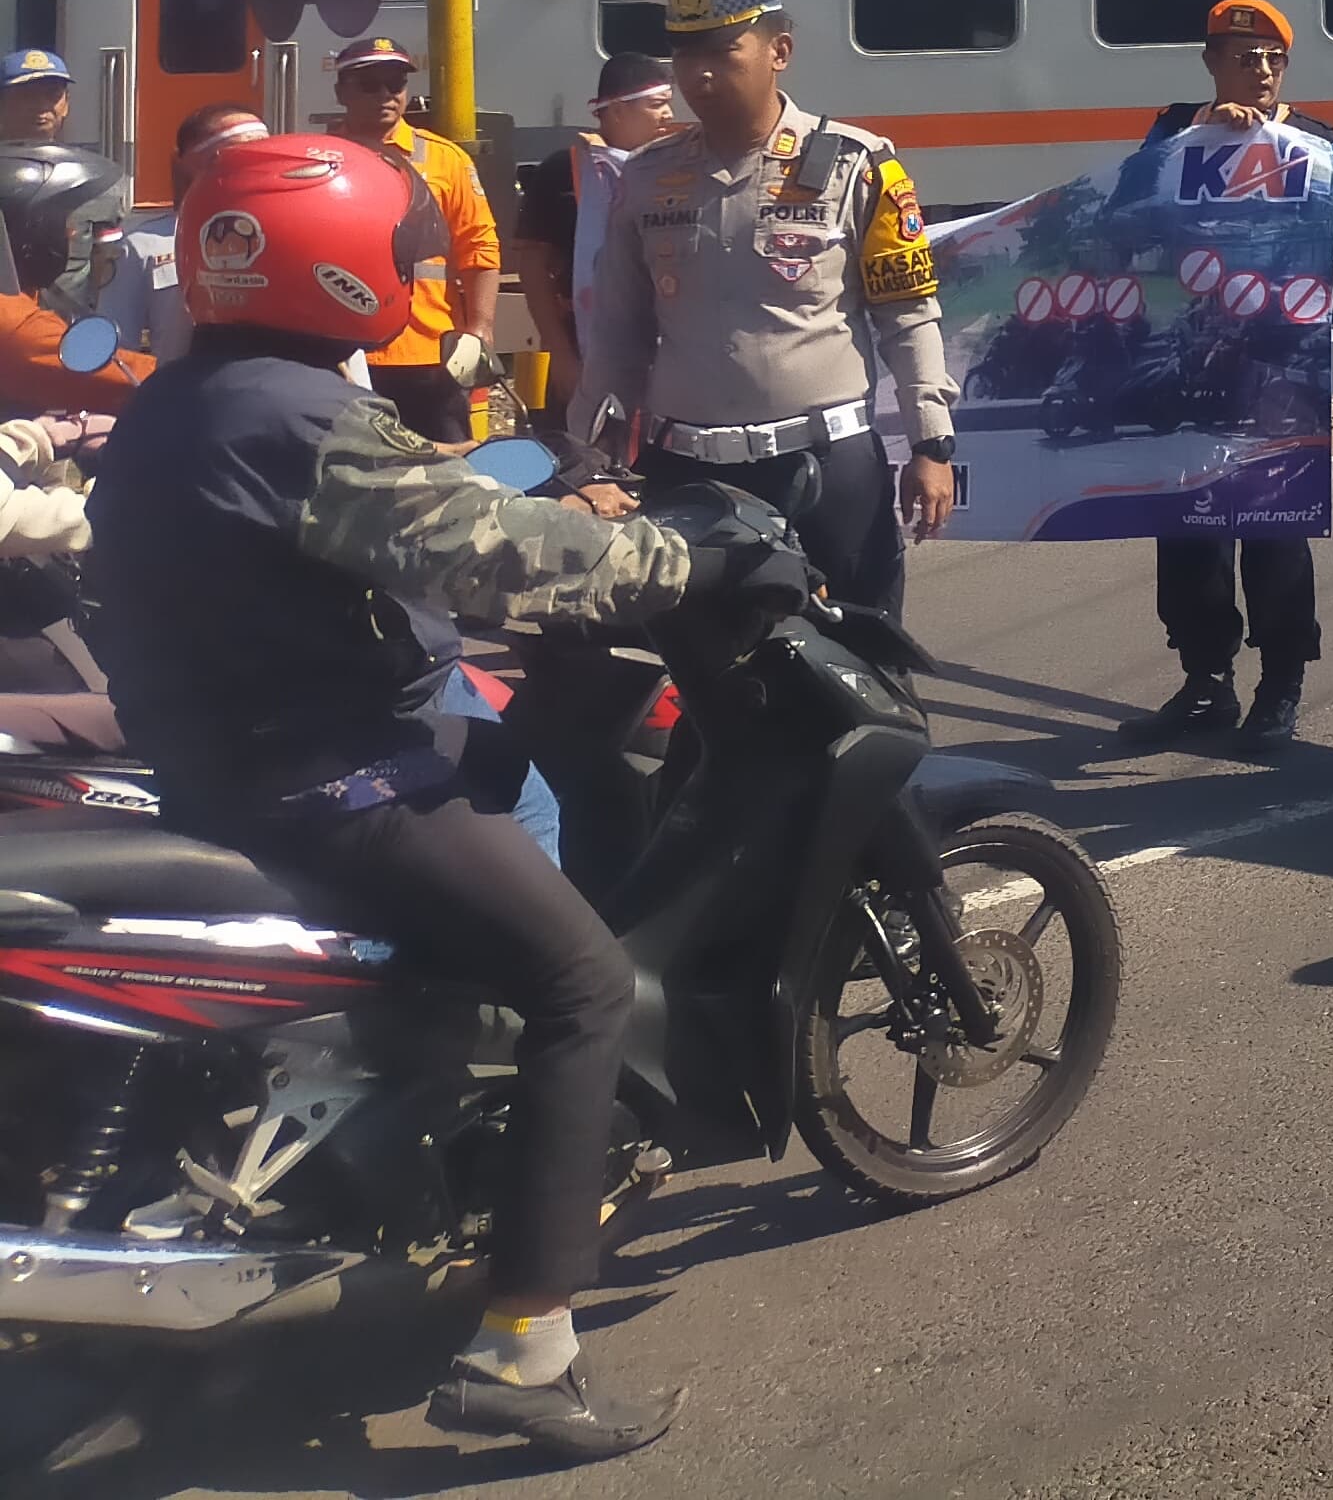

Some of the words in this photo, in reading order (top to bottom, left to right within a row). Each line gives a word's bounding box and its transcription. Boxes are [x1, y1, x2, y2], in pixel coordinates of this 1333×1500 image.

[1178, 142, 1311, 201] KAI
[759, 204, 829, 222] POLRI
[321, 269, 379, 308] INK
